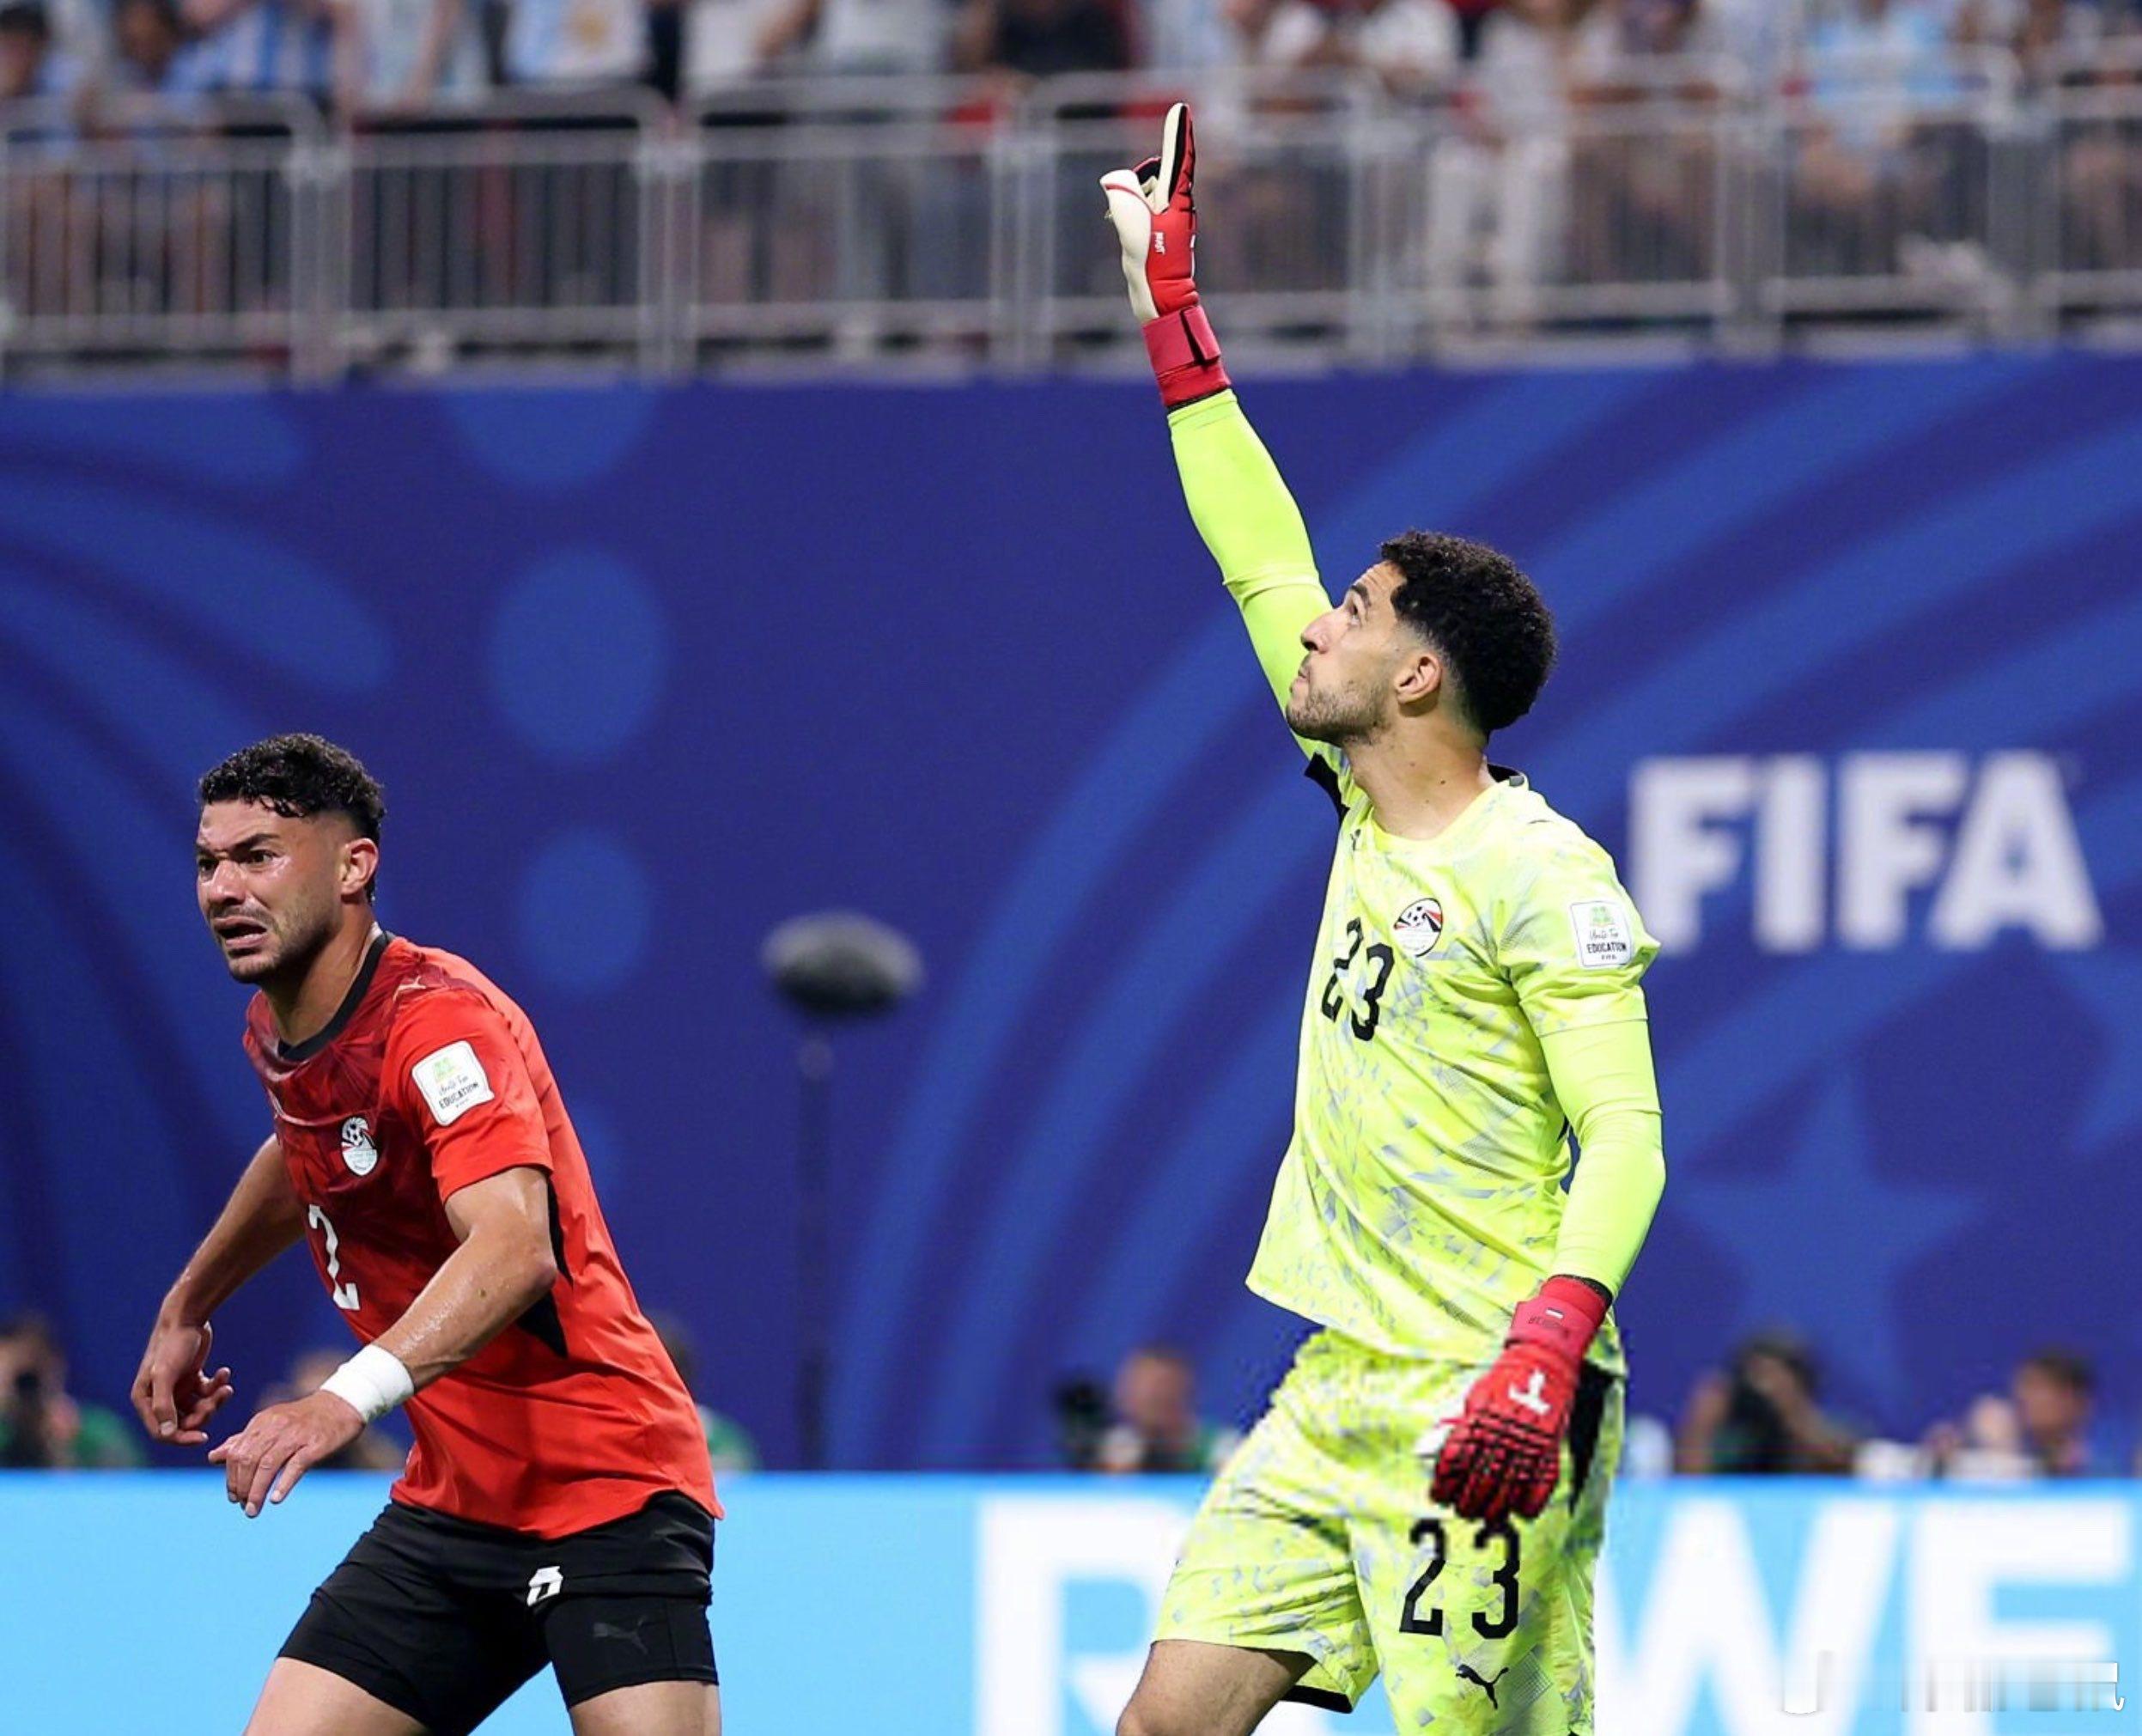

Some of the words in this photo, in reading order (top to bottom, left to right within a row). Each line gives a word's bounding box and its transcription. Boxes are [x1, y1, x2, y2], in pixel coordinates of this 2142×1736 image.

[1629, 750, 2103, 954] FIFA
[1321, 917, 1395, 1041] 23
[1585, 942, 1627, 953] EDUCATION
[308, 1204, 361, 1310] 2
[1399, 1519, 1520, 1639] 23
